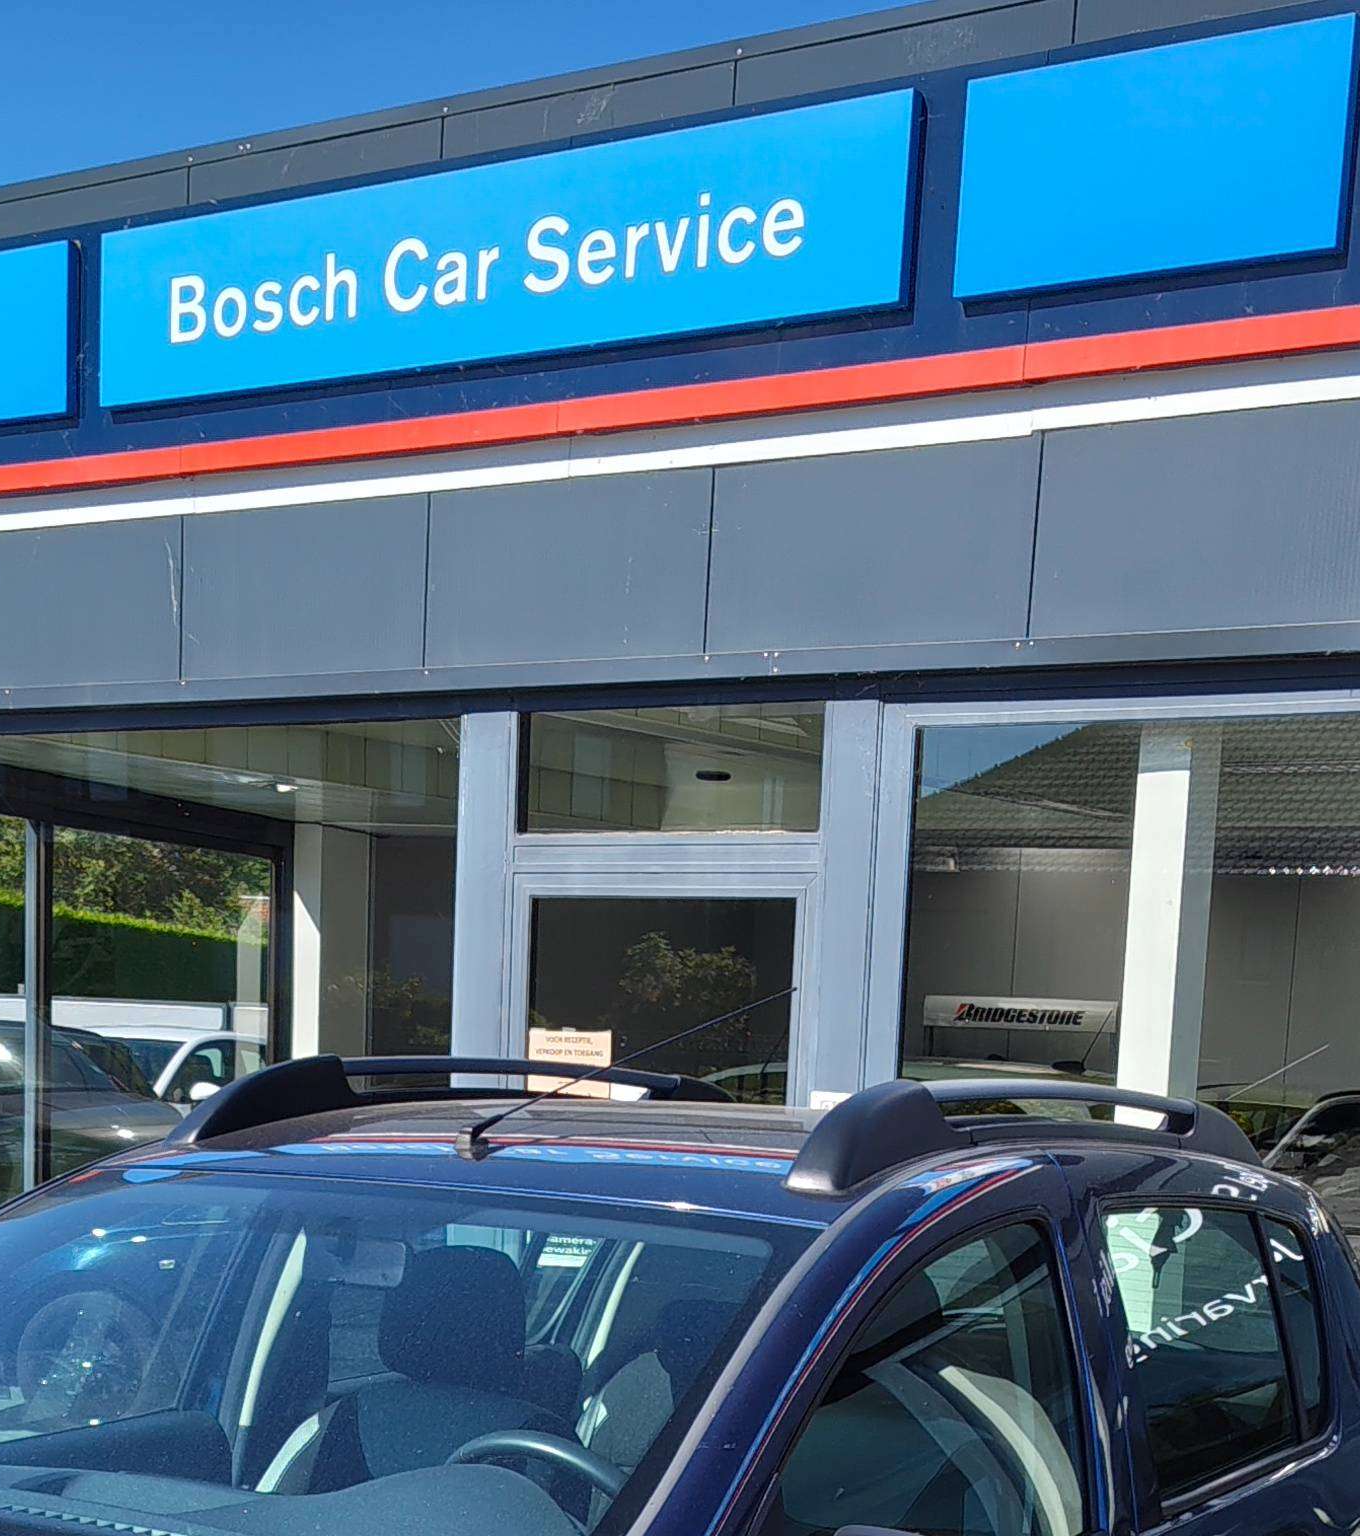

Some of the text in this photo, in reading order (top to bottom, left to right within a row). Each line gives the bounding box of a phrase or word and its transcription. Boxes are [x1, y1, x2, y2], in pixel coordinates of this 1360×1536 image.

[169, 191, 806, 344] Bosch Car Service
[953, 1003, 1086, 1026] BRIDGESTONE
